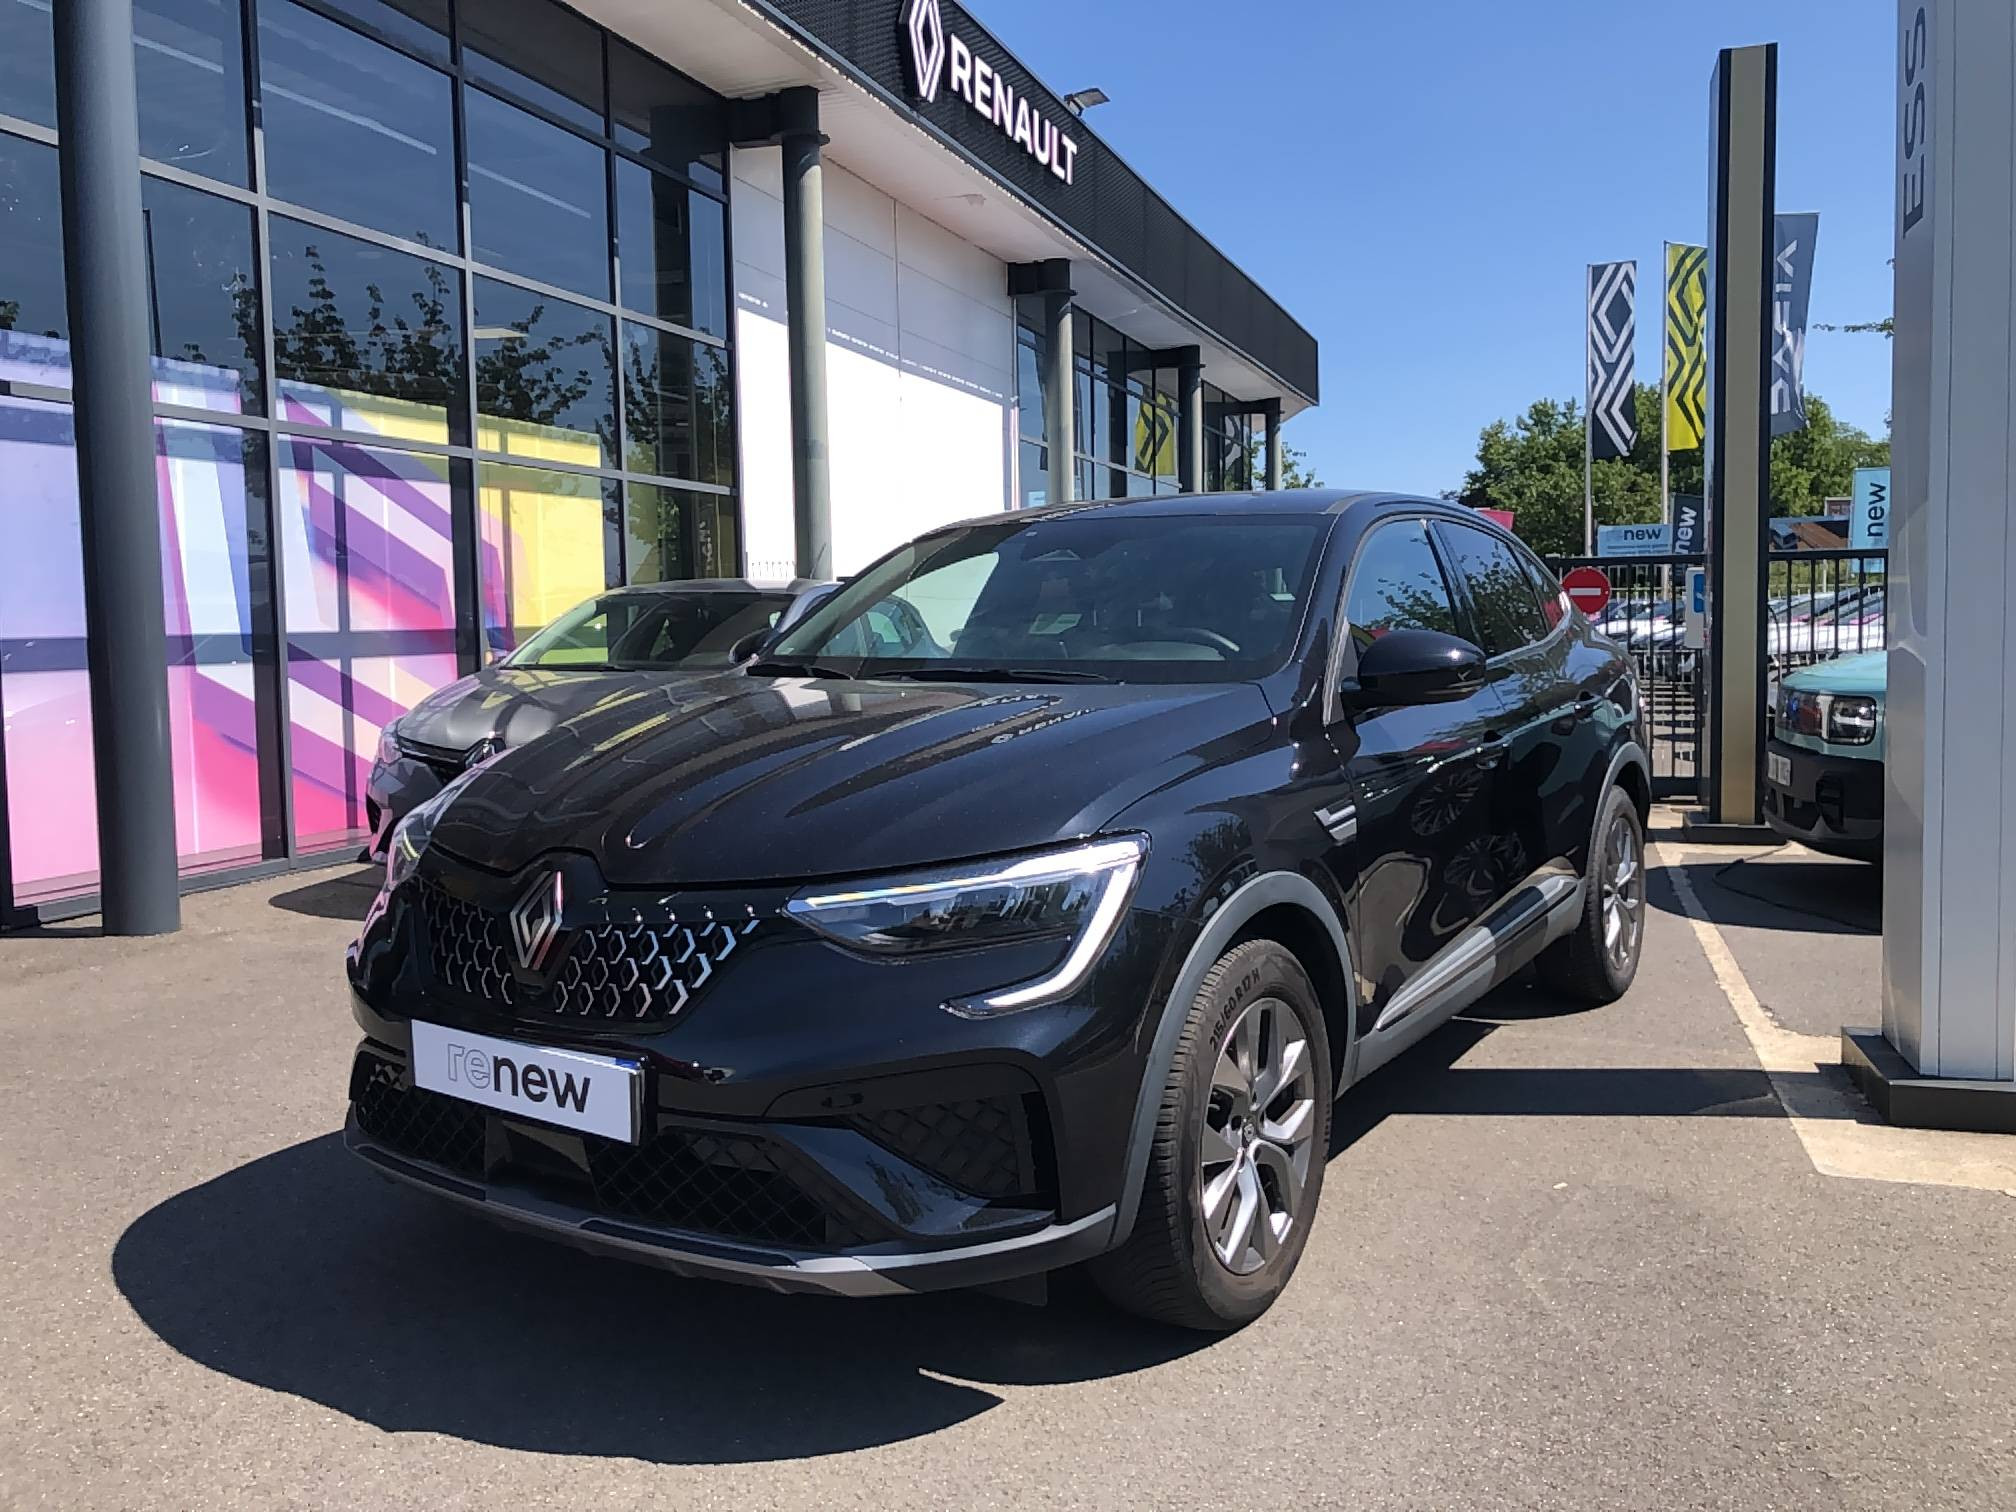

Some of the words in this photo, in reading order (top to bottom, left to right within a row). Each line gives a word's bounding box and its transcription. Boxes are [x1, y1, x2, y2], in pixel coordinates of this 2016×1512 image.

[951, 32, 1078, 186] RENAULT
[1903, 6, 1926, 240] ESS
[1770, 239, 1798, 416] DACIA
[447, 1043, 591, 1114] renew
